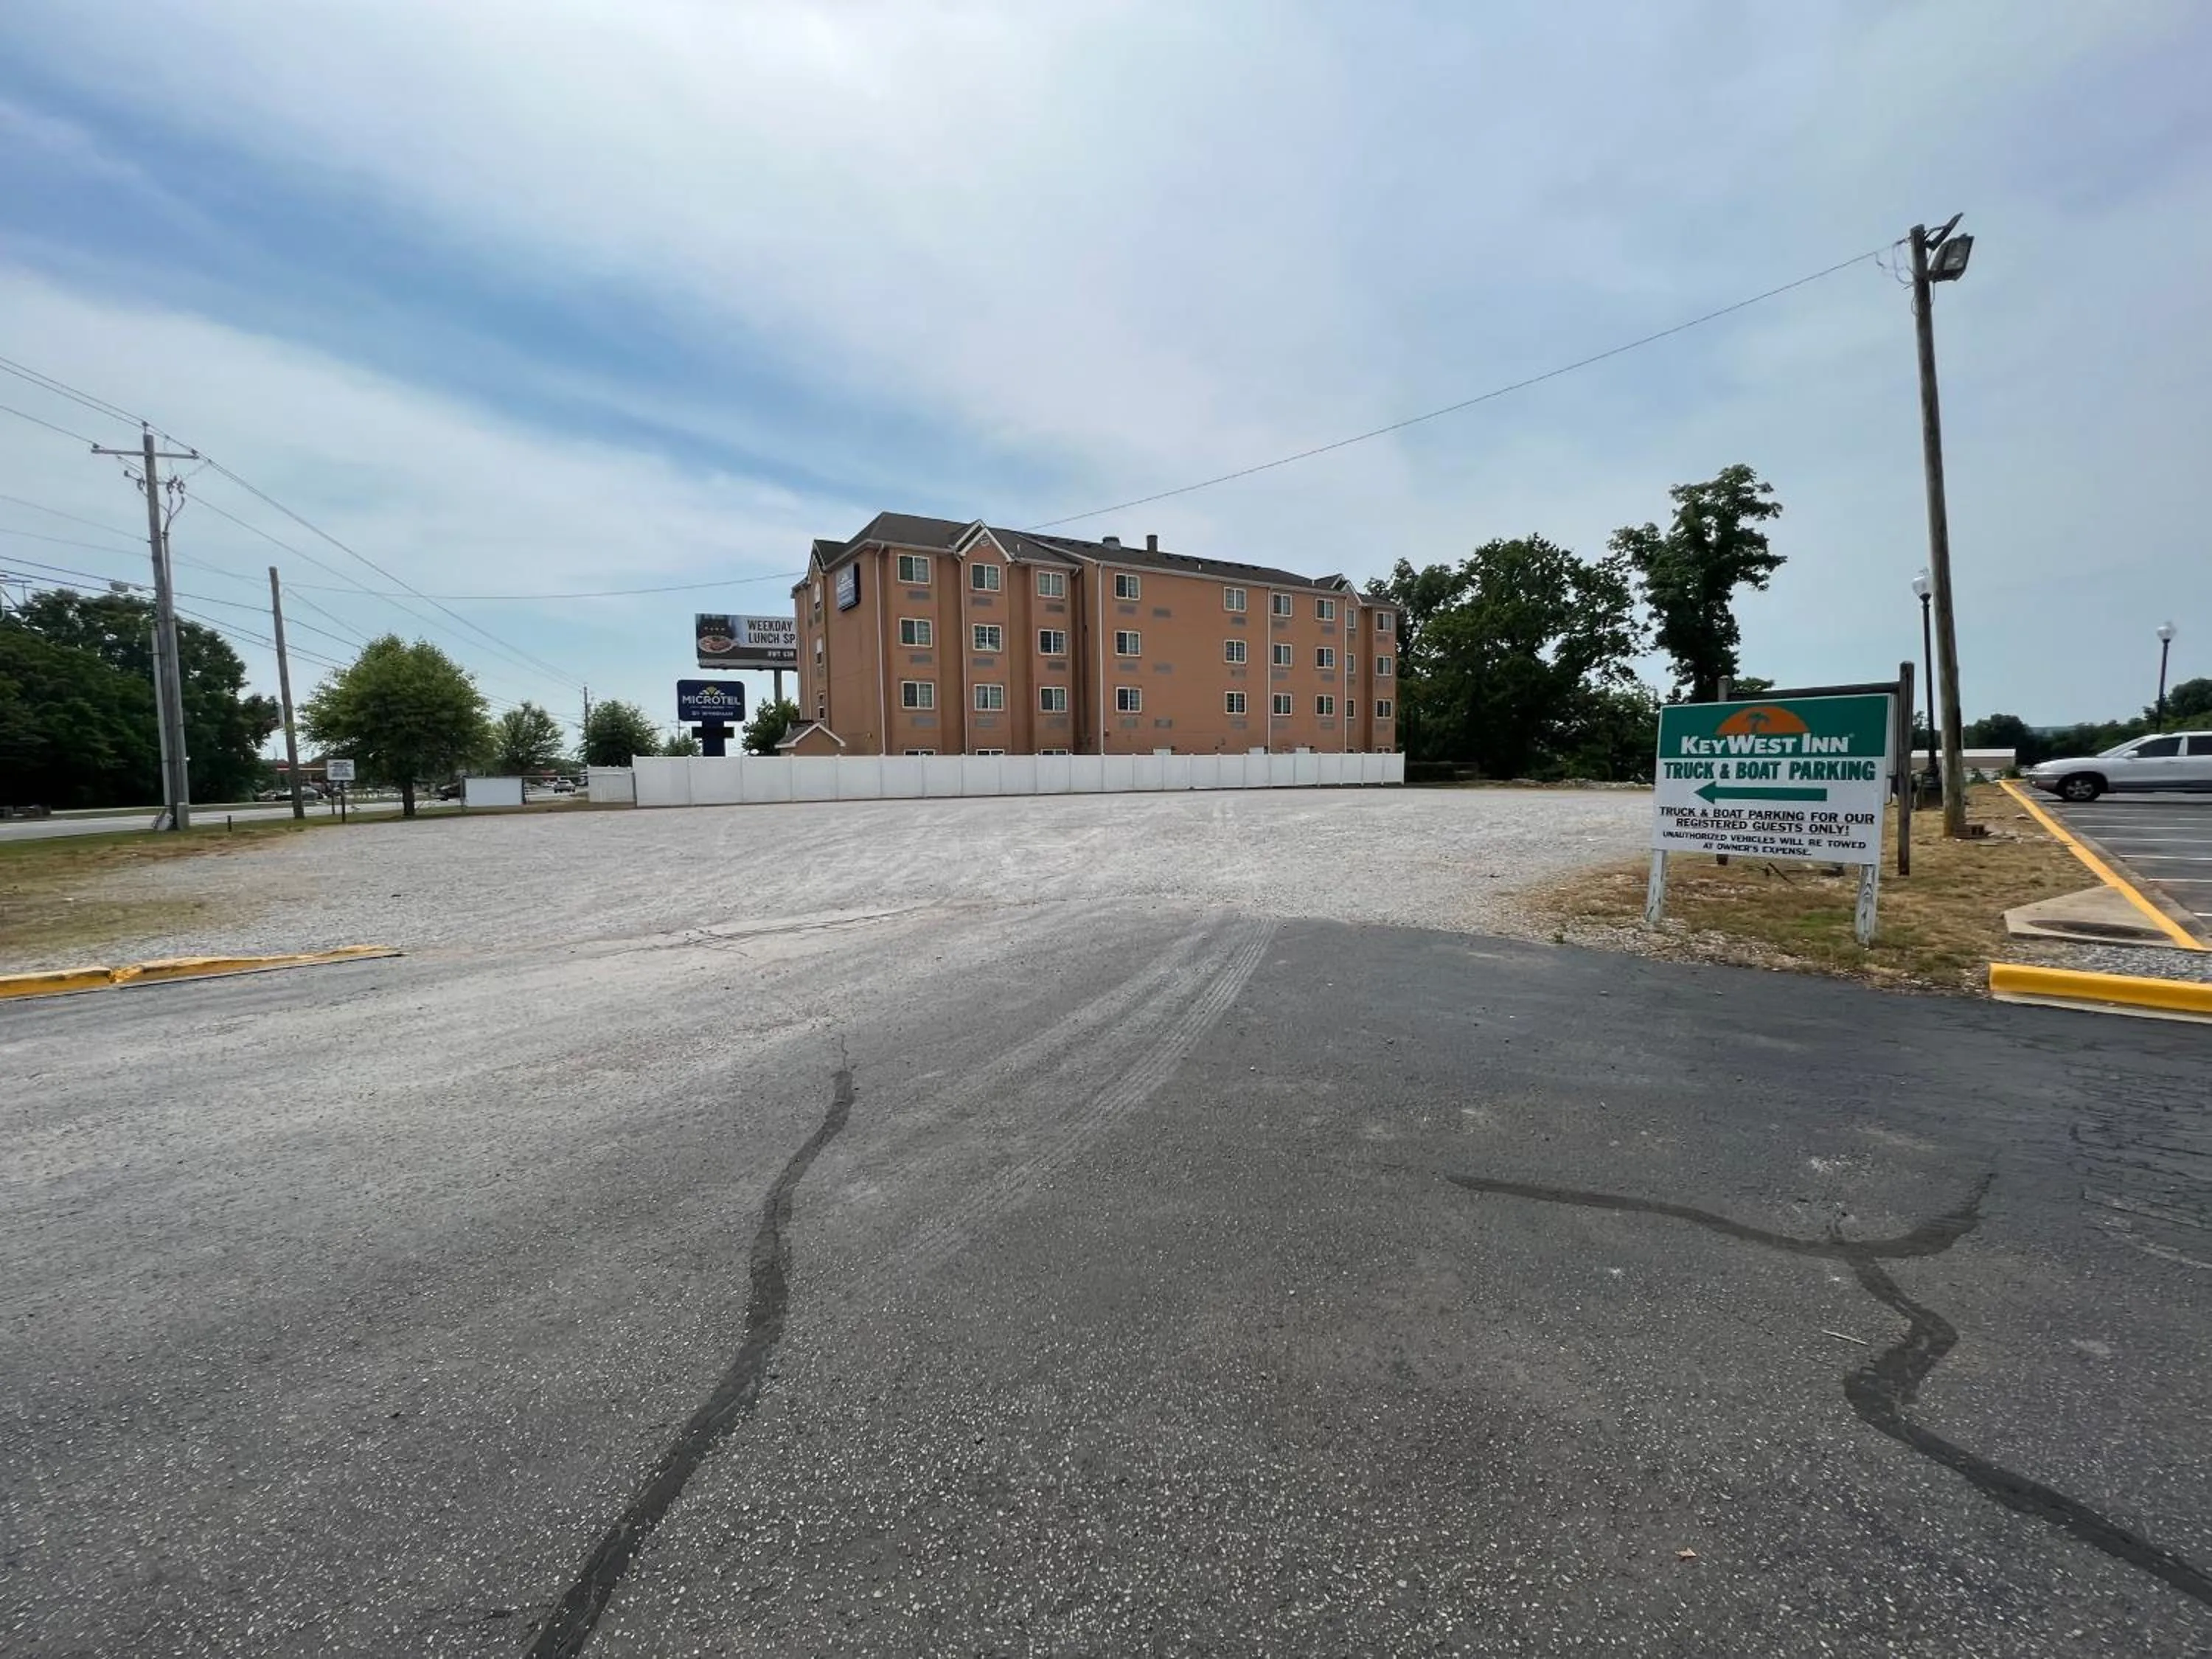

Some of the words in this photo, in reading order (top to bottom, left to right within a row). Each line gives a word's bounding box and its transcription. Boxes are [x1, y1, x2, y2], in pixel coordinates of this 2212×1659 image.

[748, 619, 793, 632] WEEKDAY
[748, 633, 779, 644] LUNCH
[682, 695, 741, 705] MICROTEL
[1664, 762, 1714, 779] TRUCK
[1719, 764, 1730, 779] &
[1736, 762, 1781, 779] BOAT
[1789, 761, 1876, 780] PARKING
[1660, 807, 1696, 817] TRUCK
[1700, 809, 1708, 818] &
[1714, 809, 1744, 818] BOAT
[1749, 810, 1804, 821] PARKING
[1811, 812, 1837, 822] FOR
[1845, 813, 1875, 824] OUR
[1676, 818, 1747, 830] REGISTERED
[1753, 822, 1803, 832] GUESTS
[1809, 824, 1850, 835] ONLY!
[1663, 831, 1727, 841] UNAUTHORIZED
[1731, 834, 1775, 844] VEHICLES
[1780, 837, 1804, 846] WILL
[1808, 838, 1822, 847] BE
[1828, 840, 1866, 849] TOWED
[1717, 843, 1759, 853] OWNER'S
